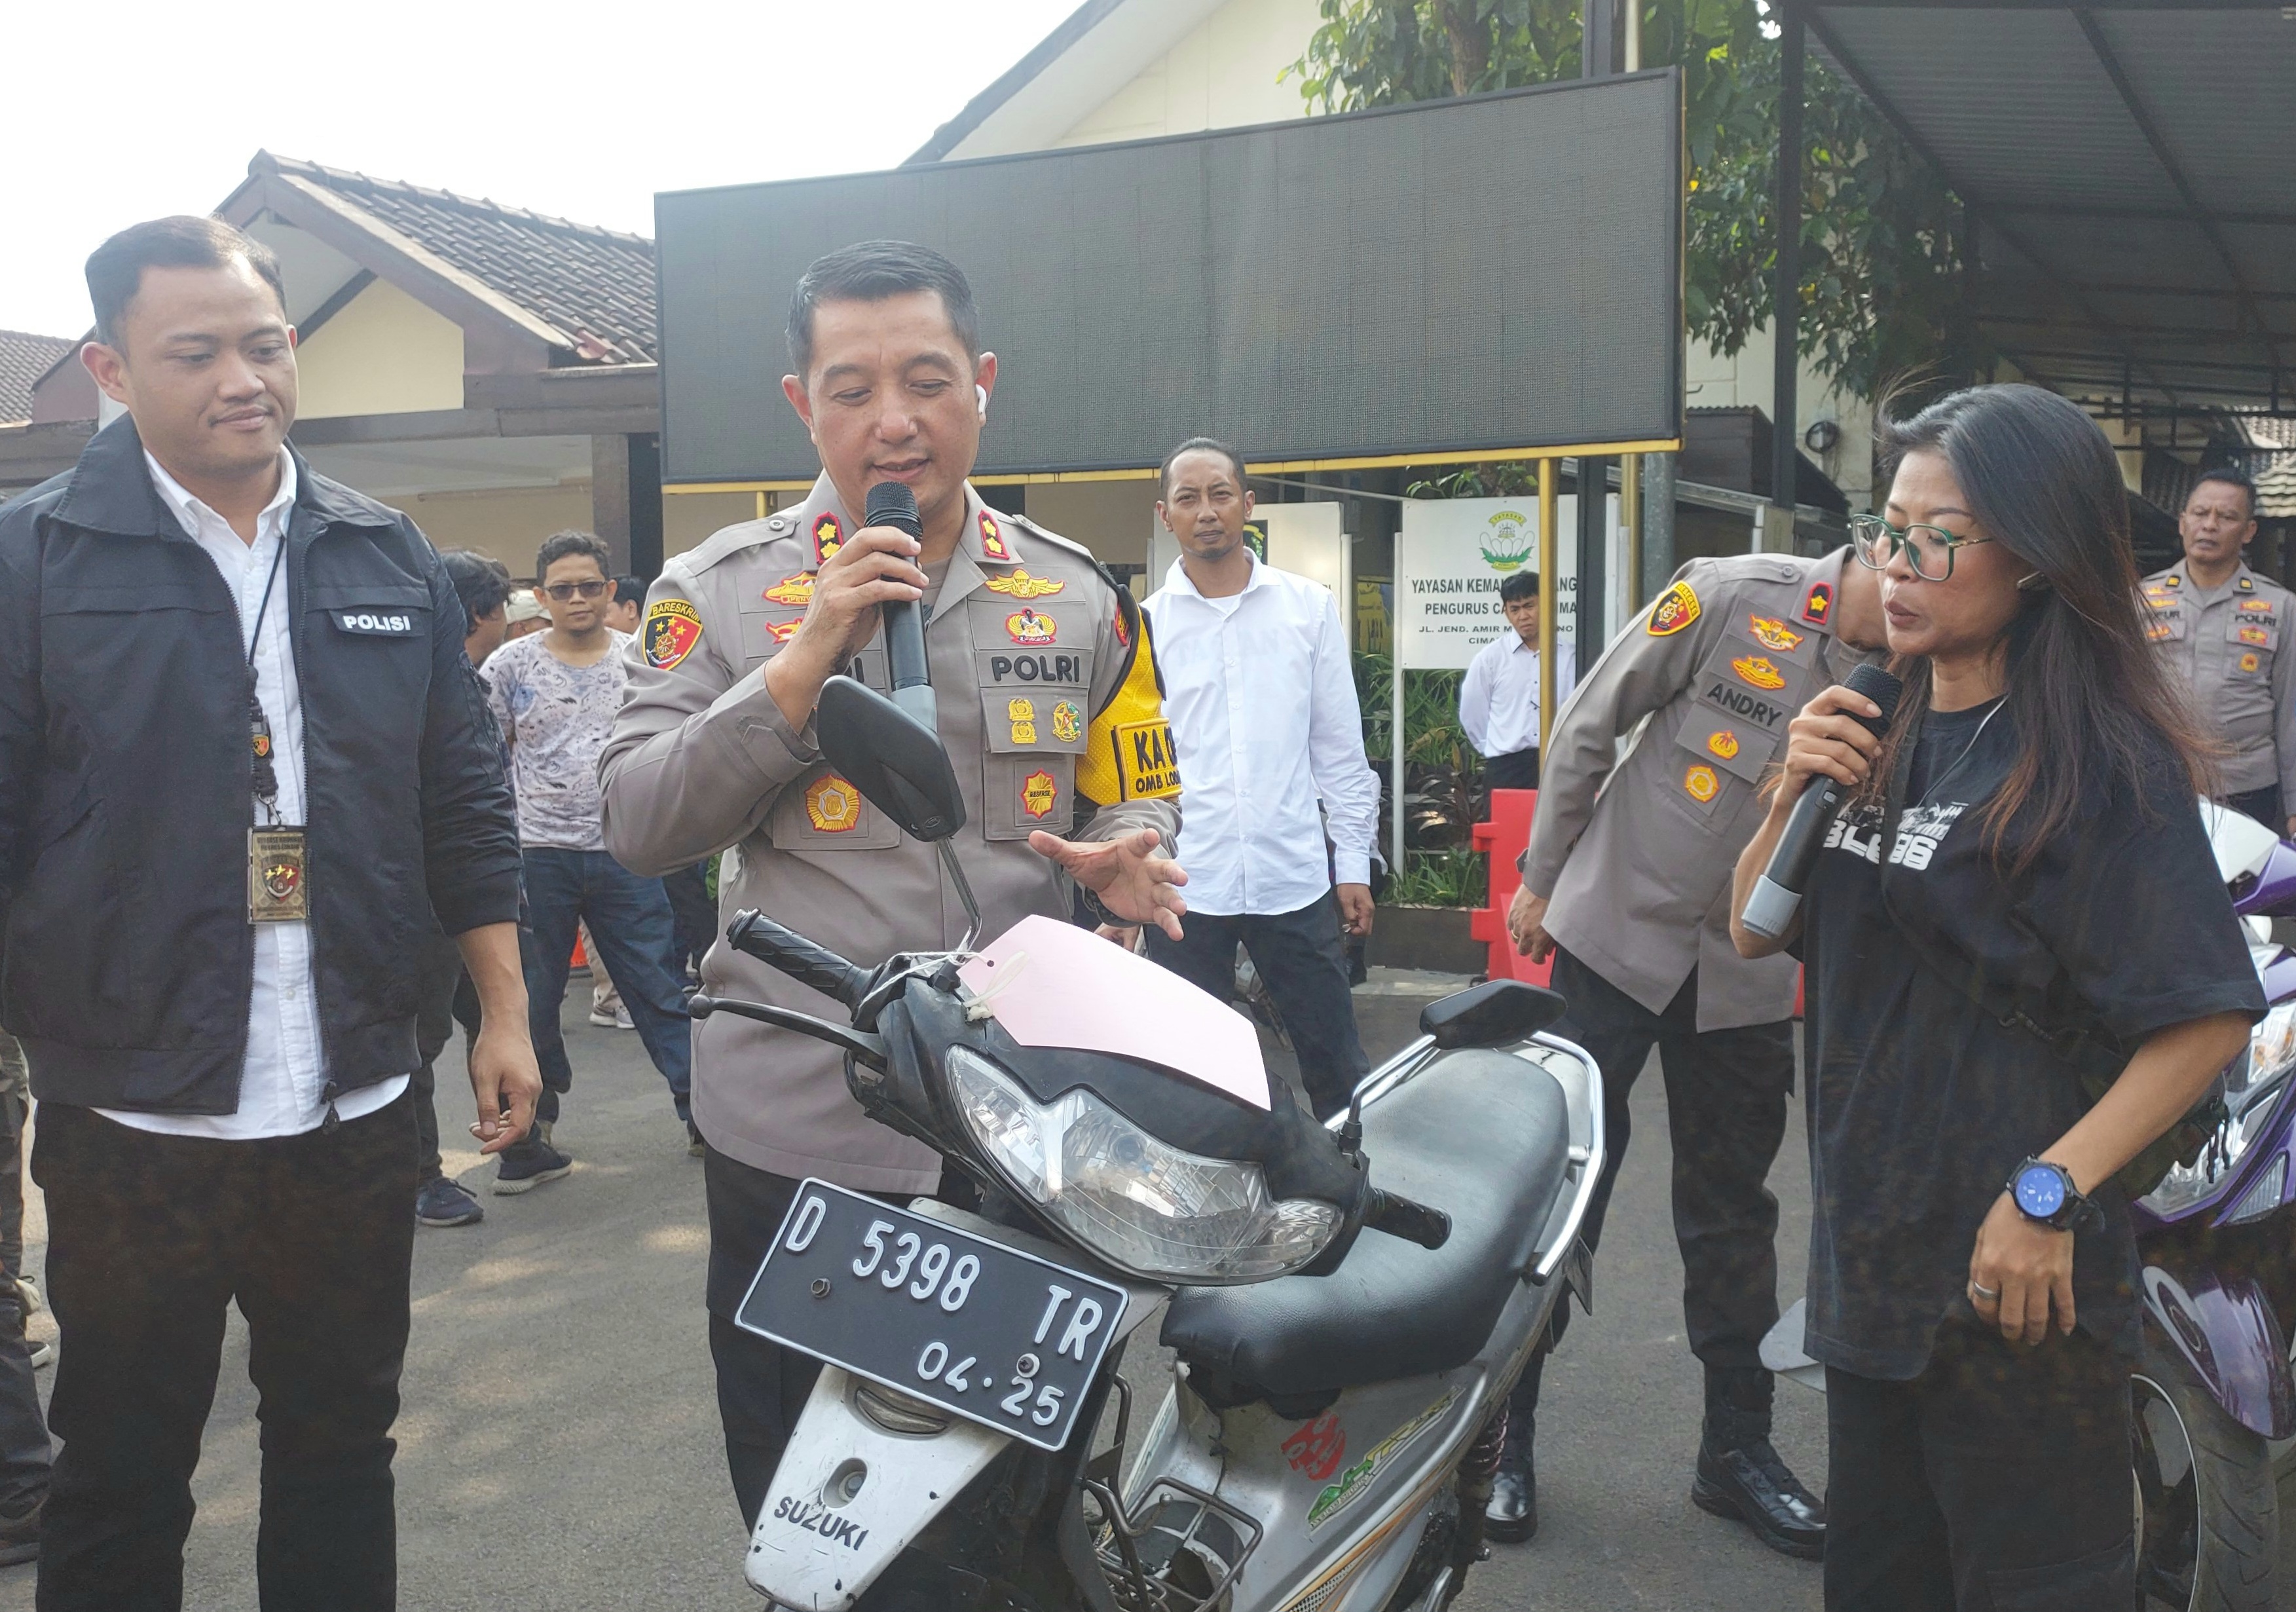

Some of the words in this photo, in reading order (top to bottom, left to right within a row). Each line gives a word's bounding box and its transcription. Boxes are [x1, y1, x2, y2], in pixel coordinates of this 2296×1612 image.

[1412, 578, 1463, 593] YAYASAN
[1425, 602, 1489, 615] PENGURUS
[343, 614, 411, 631] POLISI
[2235, 615, 2277, 627] POLRI
[991, 655, 1079, 683] POLRI
[1707, 683, 1783, 727] ANDRY
[1136, 774, 1164, 793] OMB
[786, 1196, 826, 1252] D
[852, 1219, 981, 1311] 5398
[1034, 1284, 1103, 1361] TR
[774, 1496, 870, 1551] SUZUKI
